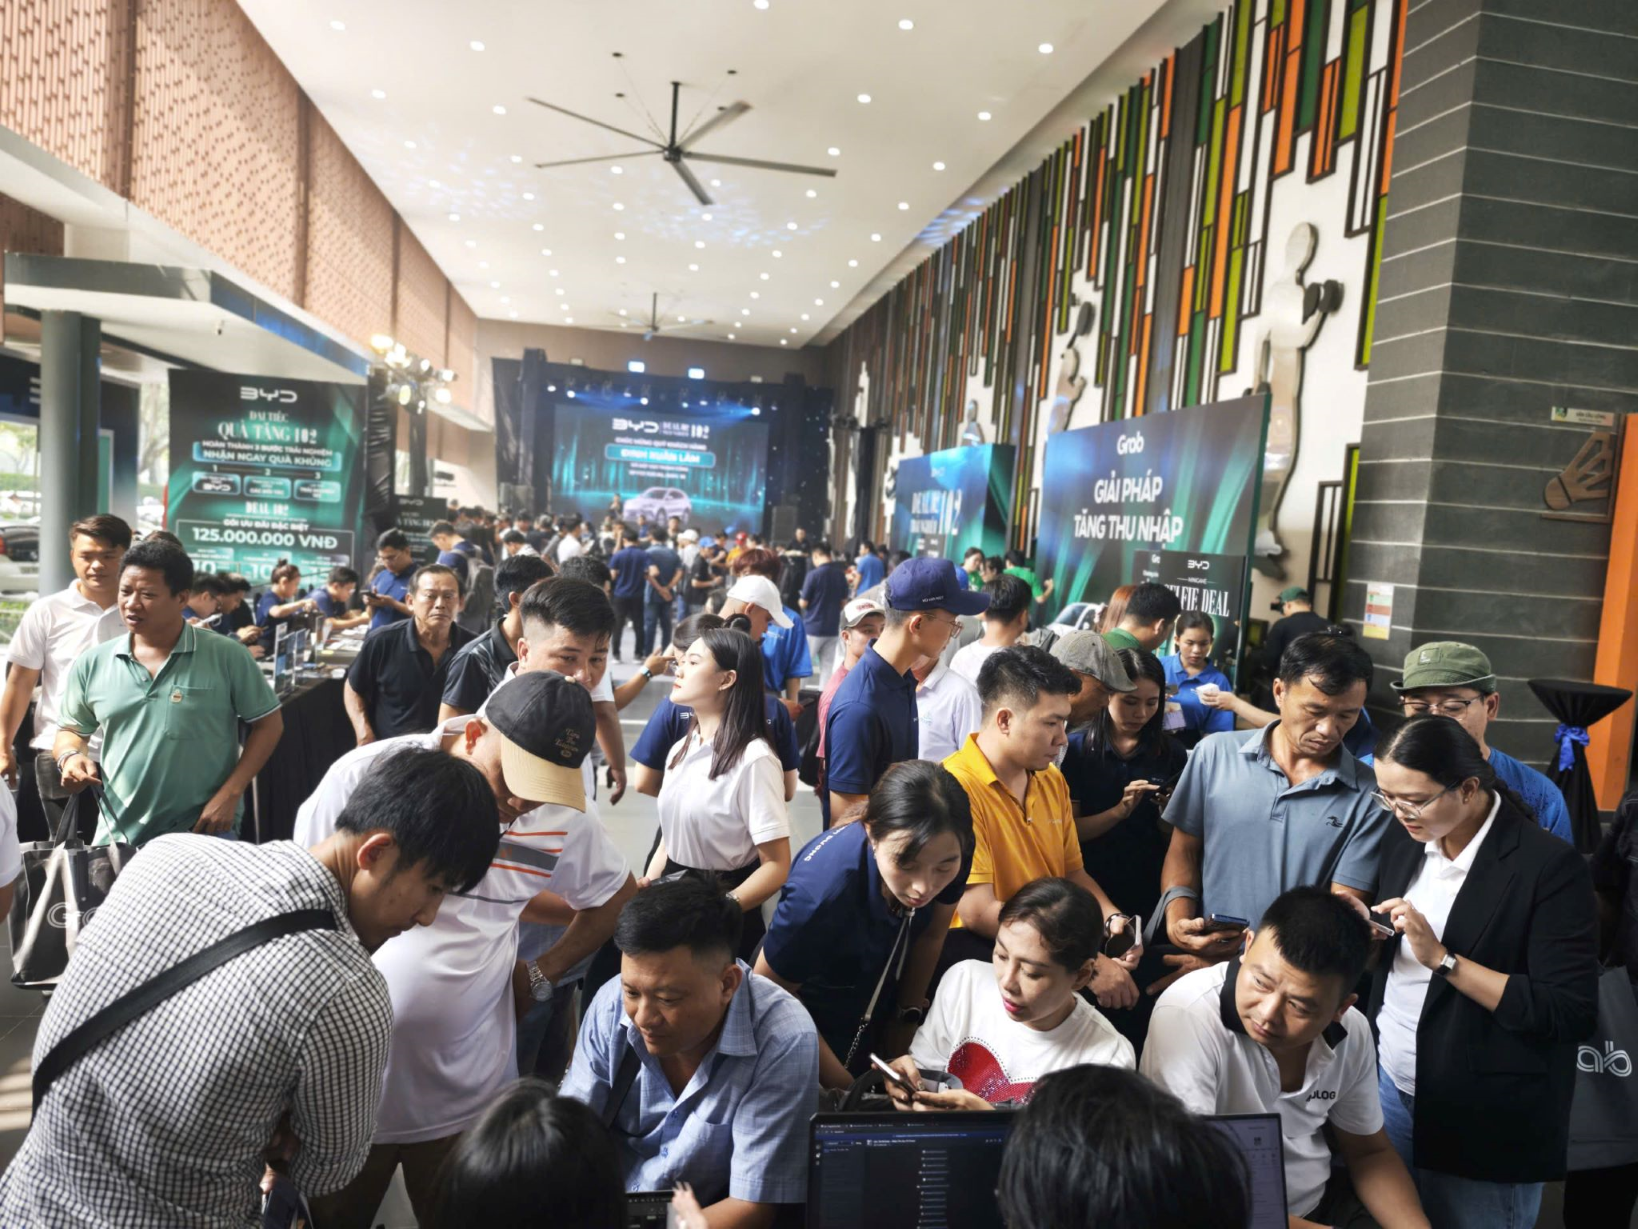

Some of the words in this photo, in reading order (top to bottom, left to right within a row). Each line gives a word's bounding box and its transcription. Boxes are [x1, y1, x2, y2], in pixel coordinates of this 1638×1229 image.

[240, 387, 297, 403] BYD
[612, 418, 660, 434] BYD
[1117, 430, 1145, 455] Grab
[237, 453, 267, 463] NGAY
[315, 471, 321, 480] 3
[1094, 470, 1121, 504] GIẢI
[1121, 468, 1163, 503] PHÁP
[192, 527, 295, 546] 125.000.000
[299, 534, 338, 549] VNĐ
[1074, 508, 1106, 539] TĂNG
[1108, 515, 1136, 541] THU
[1137, 508, 1184, 550] NHẬP
[1187, 559, 1210, 570] BYD
[1201, 589, 1230, 617] DEAL
